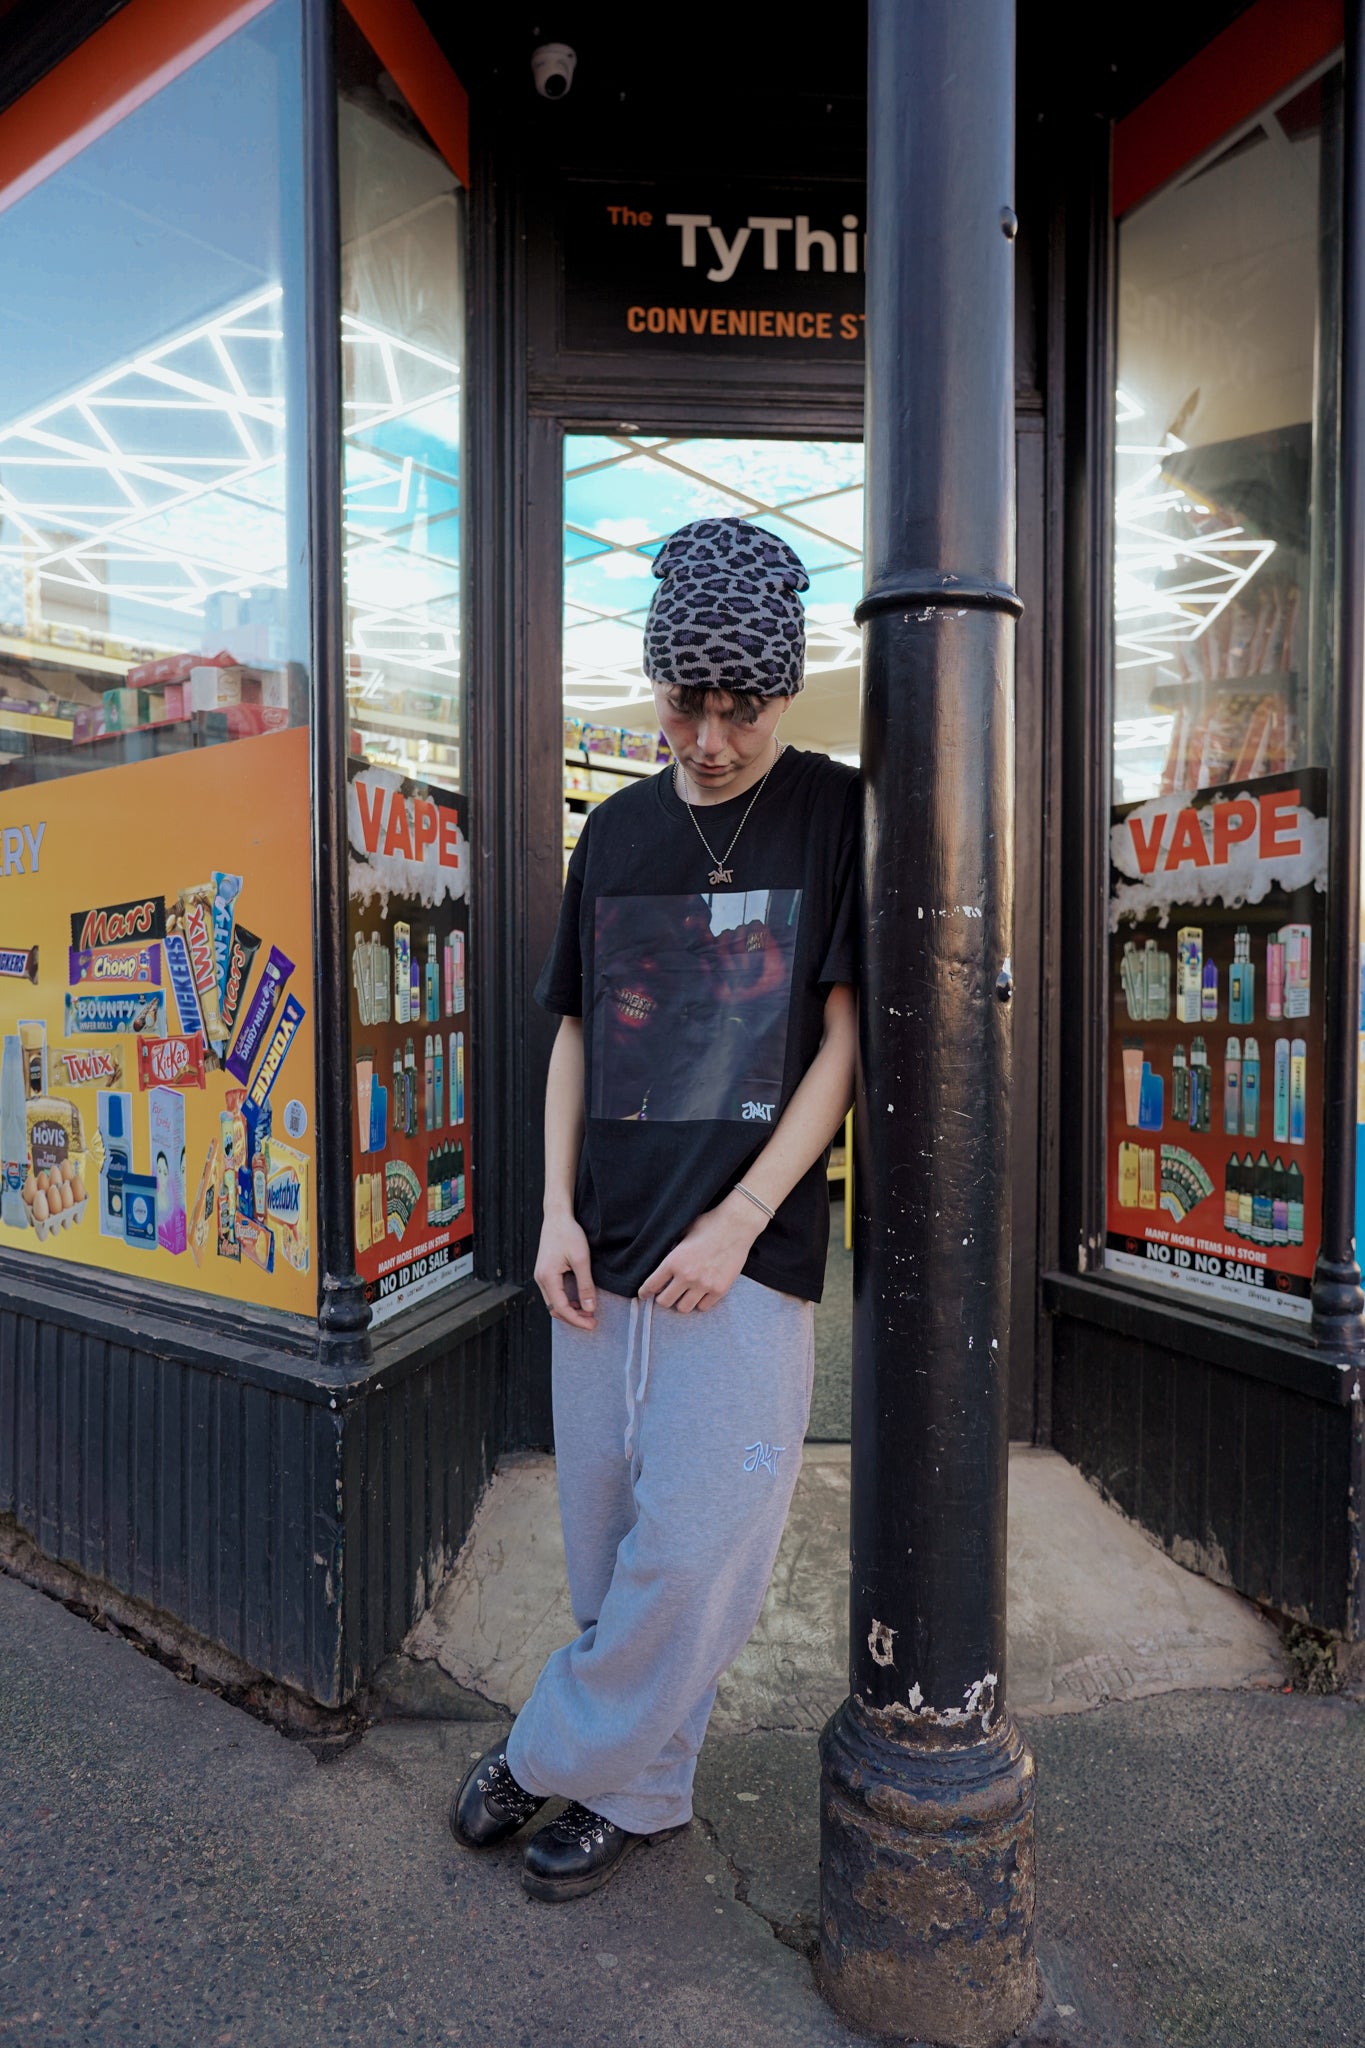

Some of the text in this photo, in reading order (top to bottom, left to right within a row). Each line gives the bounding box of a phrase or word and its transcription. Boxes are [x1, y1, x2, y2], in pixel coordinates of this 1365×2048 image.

[607, 206, 867, 282] The TyThi
[627, 306, 832, 339] CONVENIENCE
[355, 781, 459, 868] VAPE
[1128, 789, 1301, 874] VAPE
[0, 822, 47, 877] RY
[80, 902, 155, 952] Mars
[166, 936, 202, 1034] NICKERS
[79, 1000, 135, 1020] BOUNTY
[97, 1020, 113, 1030] ROLLS
[240, 998, 270, 1061] DAIRY MILK
[63, 1053, 113, 1082] TWIX
[156, 1041, 187, 1079] KitKat
[250, 1018, 295, 1106] YORKIE
[33, 1127, 65, 1147] HOVIS
[378, 1232, 450, 1273] MANY MORE ITEMS IN STORE
[1145, 1227, 1267, 1264] MANY MORE ITEMS IN STORE
[1146, 1242, 1171, 1262] NO
[1174, 1248, 1191, 1268] ID
[1194, 1253, 1221, 1275] NO
[1224, 1261, 1265, 1286] SALE
[380, 1274, 397, 1297] NO
[399, 1267, 410, 1287] ID
[412, 1259, 427, 1281] NO
[428, 1248, 449, 1272] SALE
